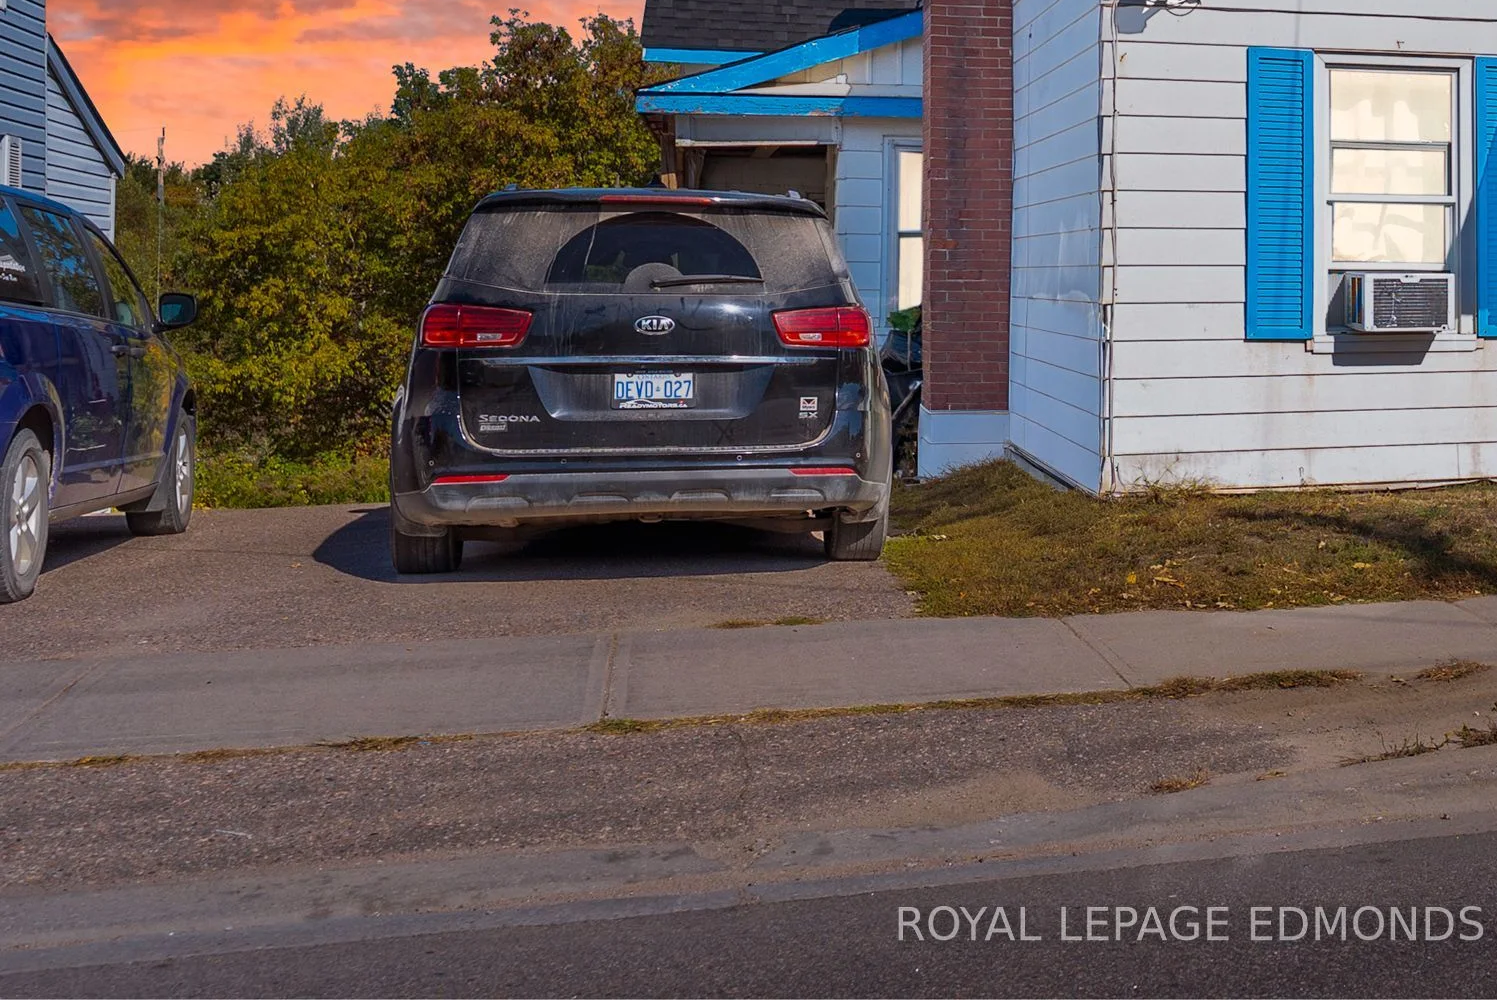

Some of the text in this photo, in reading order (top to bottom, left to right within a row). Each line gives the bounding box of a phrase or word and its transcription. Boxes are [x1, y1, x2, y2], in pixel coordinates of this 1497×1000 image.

[641, 319, 671, 331] KIA
[616, 380, 692, 400] DEVD 027
[478, 414, 541, 423] SEDONA
